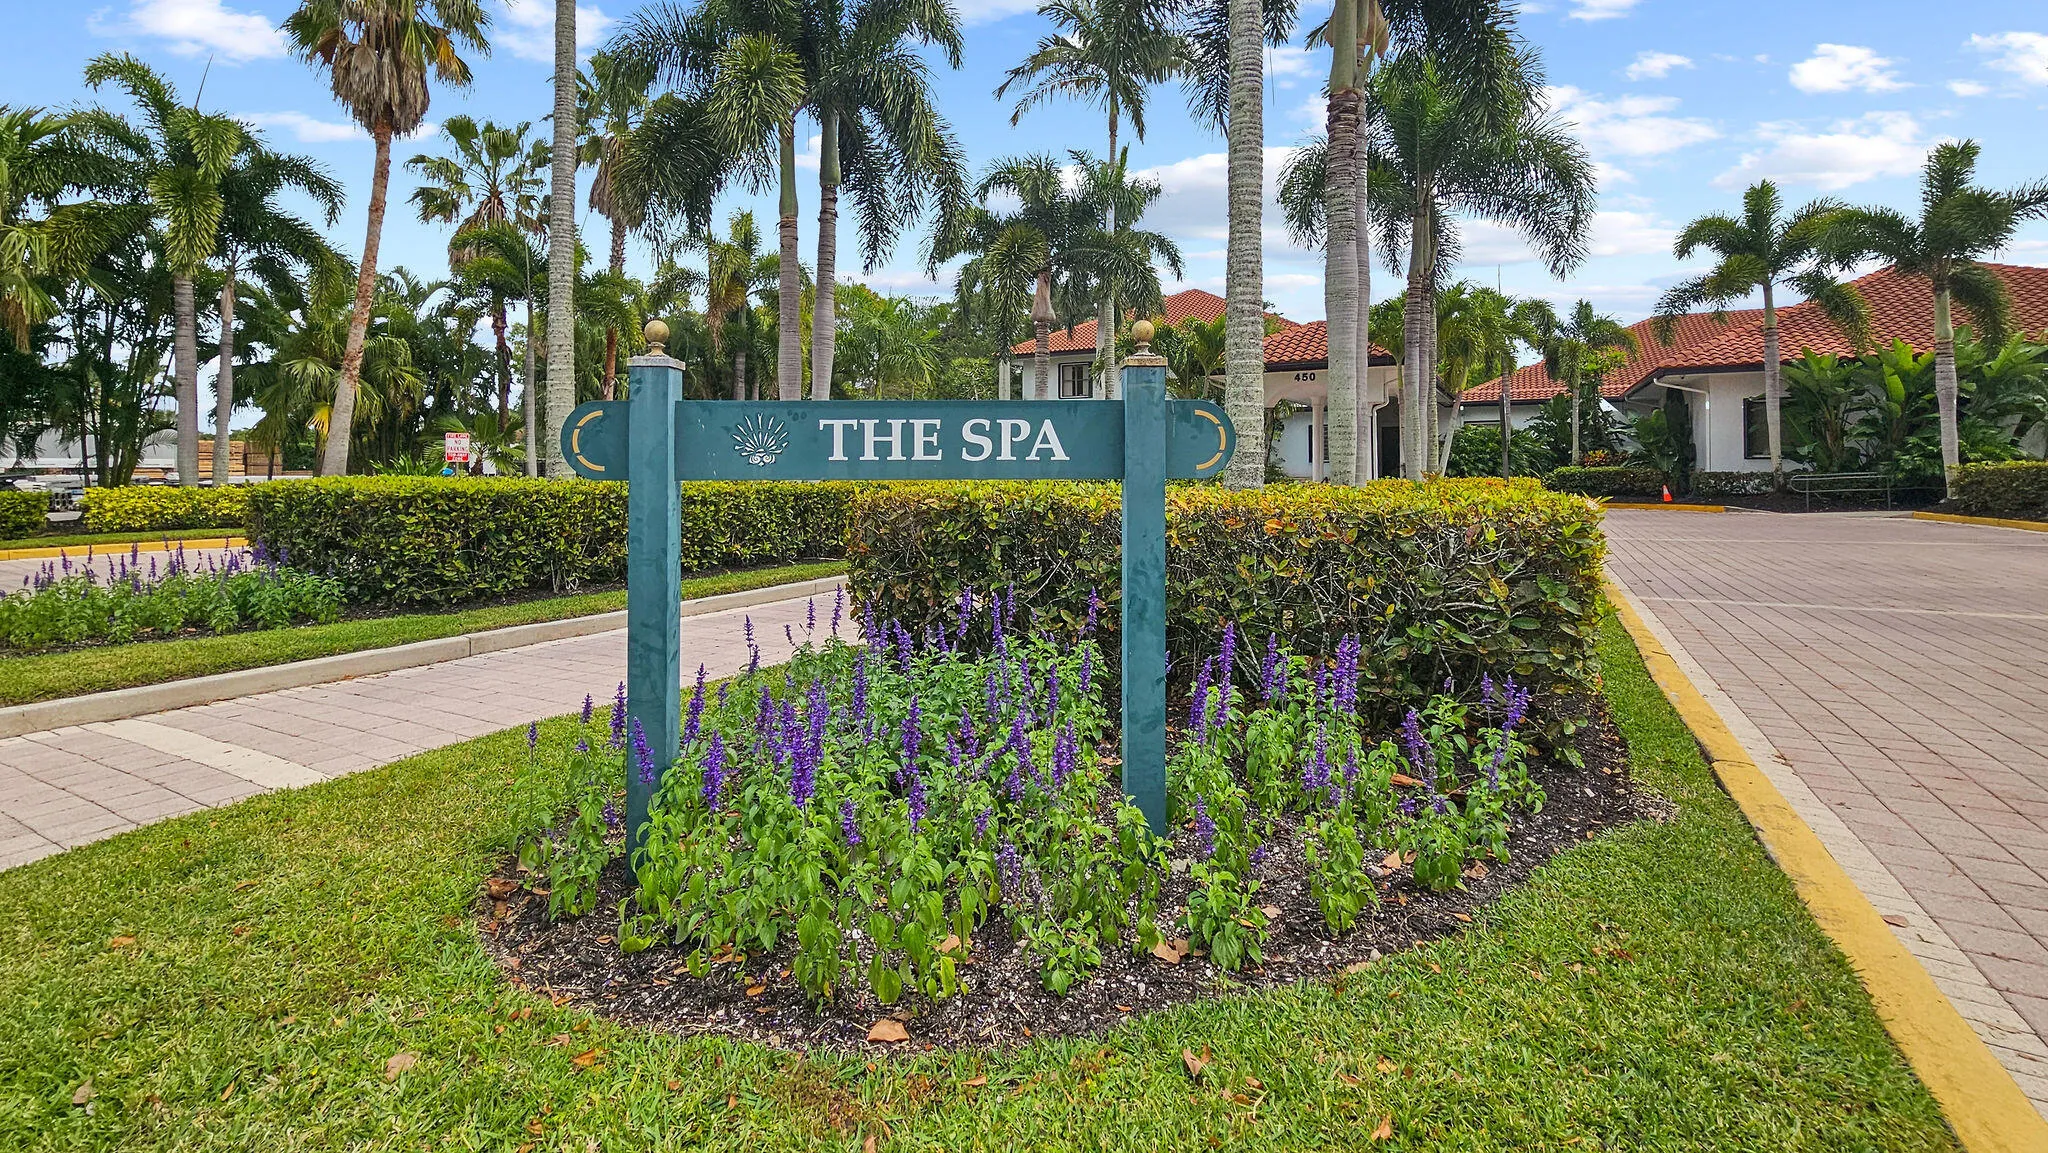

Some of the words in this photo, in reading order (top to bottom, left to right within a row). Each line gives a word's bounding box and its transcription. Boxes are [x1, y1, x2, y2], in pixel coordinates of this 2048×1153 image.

[1294, 372, 1316, 382] 450
[819, 419, 943, 461] THE
[961, 418, 1071, 462] SPA
